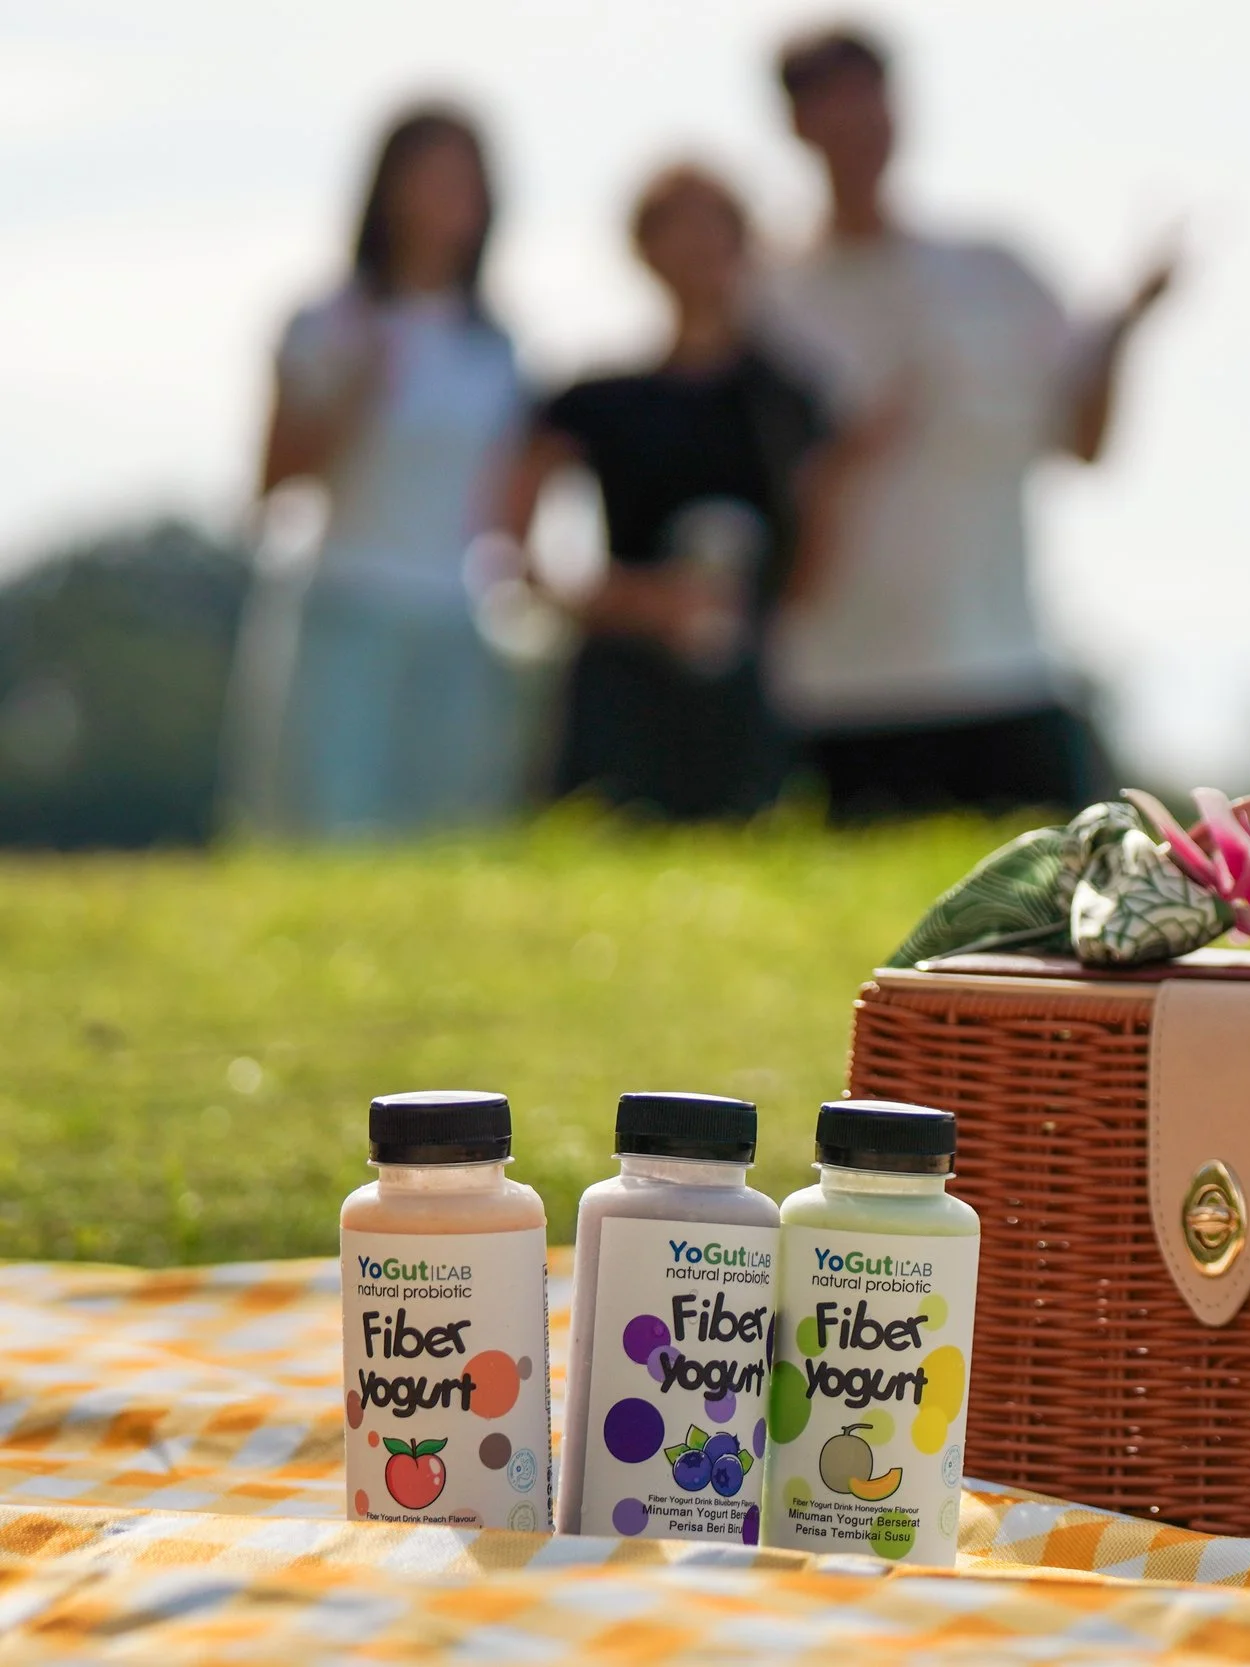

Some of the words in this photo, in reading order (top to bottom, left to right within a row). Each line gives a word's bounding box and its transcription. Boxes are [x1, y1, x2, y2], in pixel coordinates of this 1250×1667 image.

[666, 1266, 719, 1281] natural
[723, 1270, 770, 1285] probiotic
[812, 1274, 862, 1291] natural
[865, 1278, 932, 1294] probiotic
[357, 1284, 399, 1298] natural
[403, 1284, 472, 1301] probiotic
[672, 1291, 767, 1343] Fiber
[816, 1300, 929, 1351] Fiber
[362, 1307, 472, 1359] Fiber
[648, 1494, 667, 1504] Fiber
[669, 1496, 694, 1506] Yogurt
[694, 1498, 713, 1506] Drink
[792, 1497, 809, 1507] Fiber
[809, 1500, 833, 1511] Yogurt
[833, 1502, 853, 1511] Drink
[854, 1505, 894, 1514] Honeydew
[894, 1506, 919, 1514] Flavour
[366, 1511, 380, 1521] Fiber
[381, 1514, 402, 1524] Yogurt
[402, 1515, 421, 1523] Drink
[422, 1515, 447, 1524] Peach
[449, 1515, 477, 1524] Flavour
[642, 1504, 693, 1518] Minuman
[696, 1507, 728, 1521] Yogurt
[788, 1508, 833, 1523] Minuman
[836, 1514, 874, 1528] Yogurt
[876, 1517, 921, 1528] Berserat
[669, 1520, 703, 1533] Perisa
[707, 1522, 725, 1534] Beri
[727, 1523, 743, 1534] Biru
[795, 1523, 827, 1537] Perisa
[830, 1527, 881, 1541] Tembikai
[884, 1531, 911, 1542] Susu
